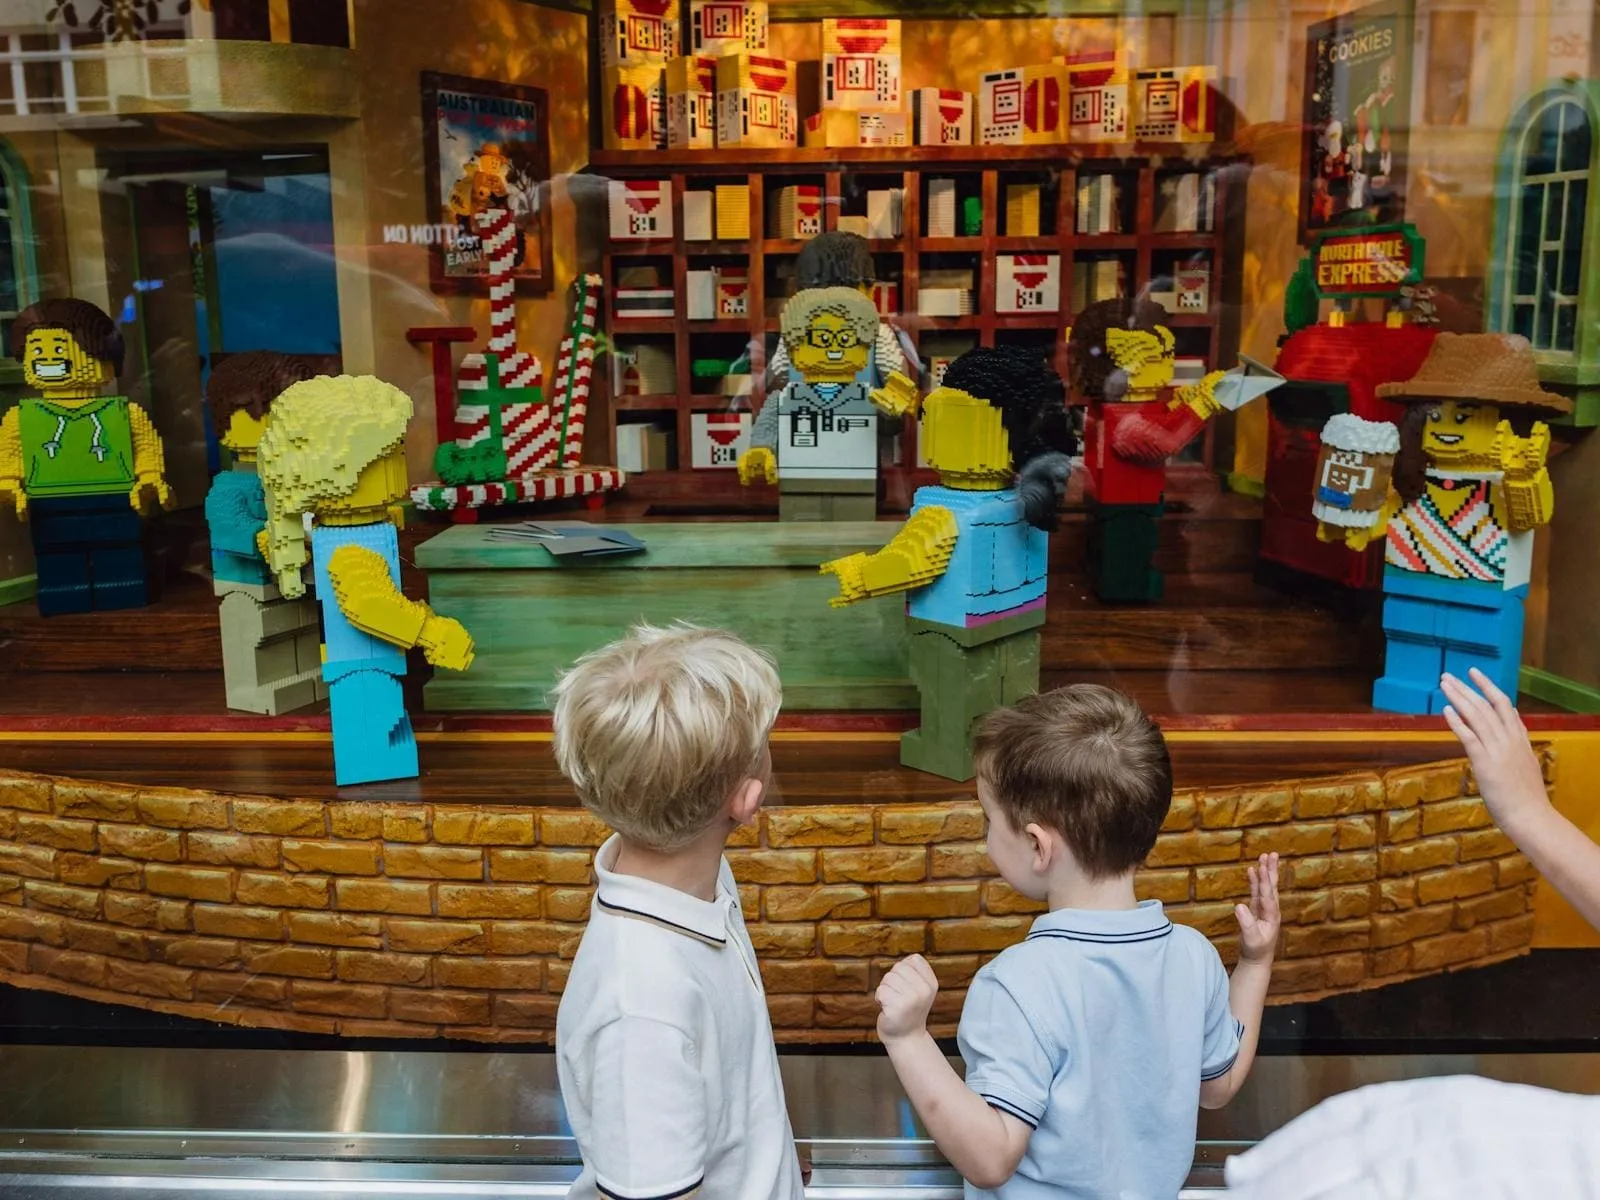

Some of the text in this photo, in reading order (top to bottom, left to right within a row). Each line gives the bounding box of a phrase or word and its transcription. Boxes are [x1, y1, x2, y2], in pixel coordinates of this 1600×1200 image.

[1329, 28, 1392, 63] COOKIES
[438, 92, 534, 119] AUSTRALIAN
[1320, 242, 1365, 261] NORTH
[1318, 260, 1406, 286] EXPRESS
